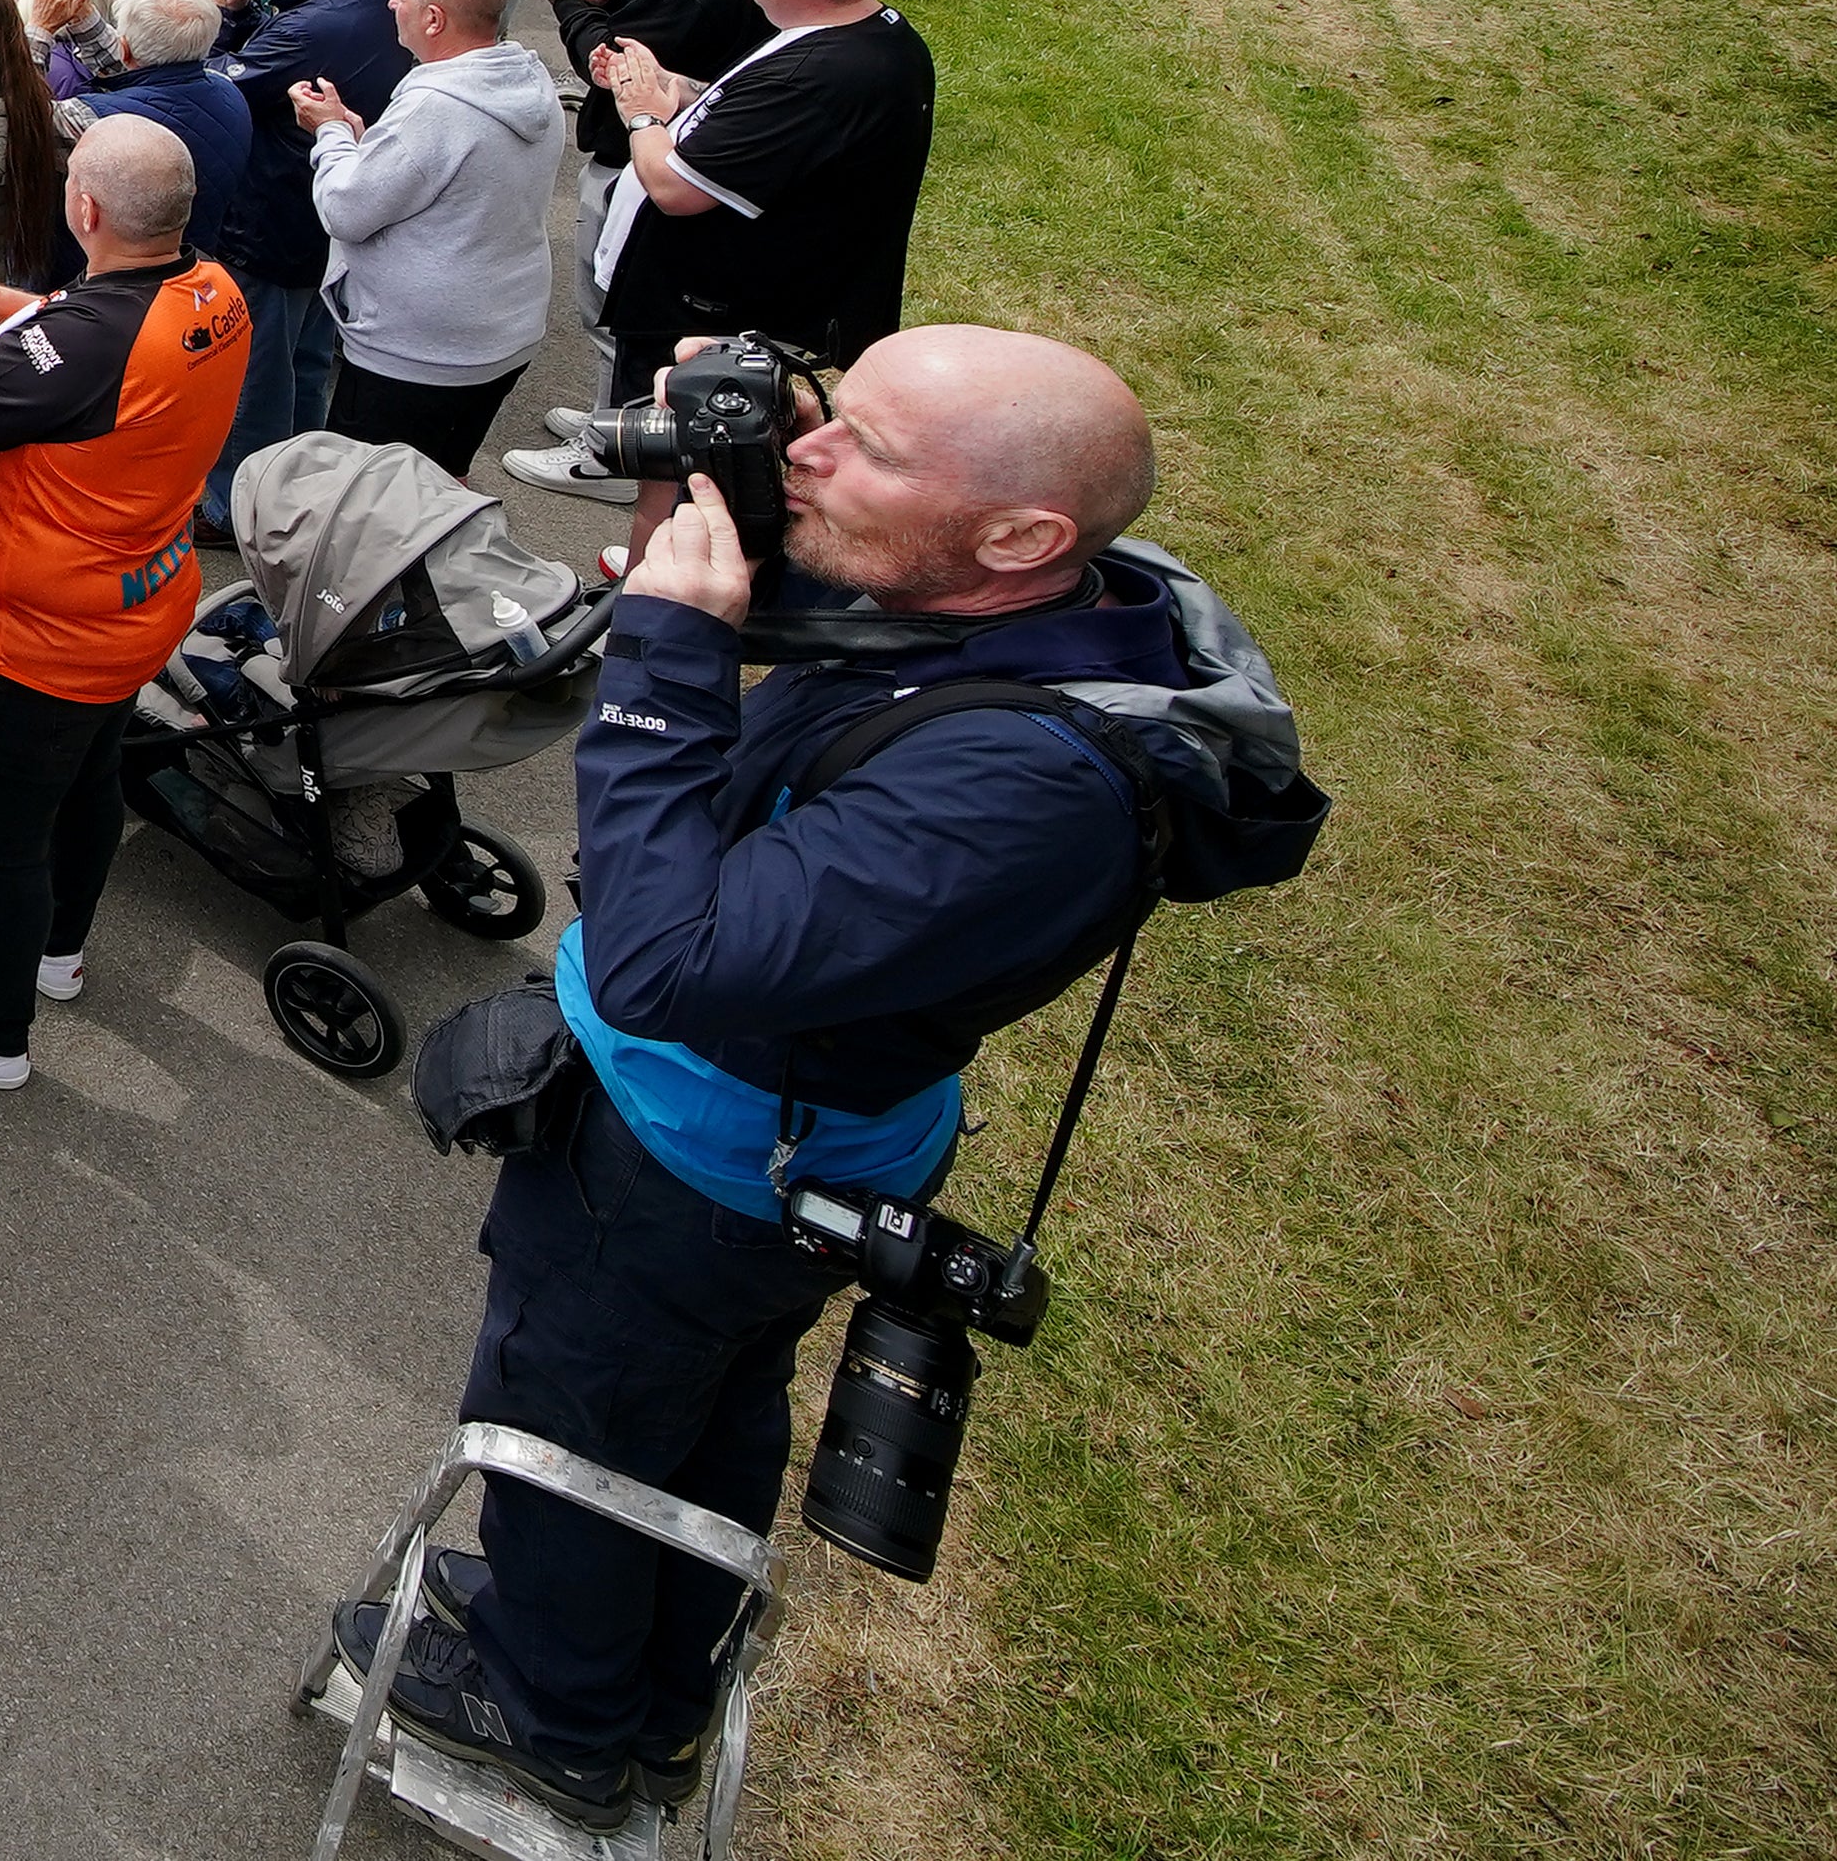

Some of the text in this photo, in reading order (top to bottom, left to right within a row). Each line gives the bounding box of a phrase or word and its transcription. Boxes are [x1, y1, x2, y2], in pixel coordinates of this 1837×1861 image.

[211, 296, 246, 339] Castle
[316, 589, 346, 614] Joie
[599, 708, 666, 732] GORE-TEX
[301, 765, 321, 803] Joie
